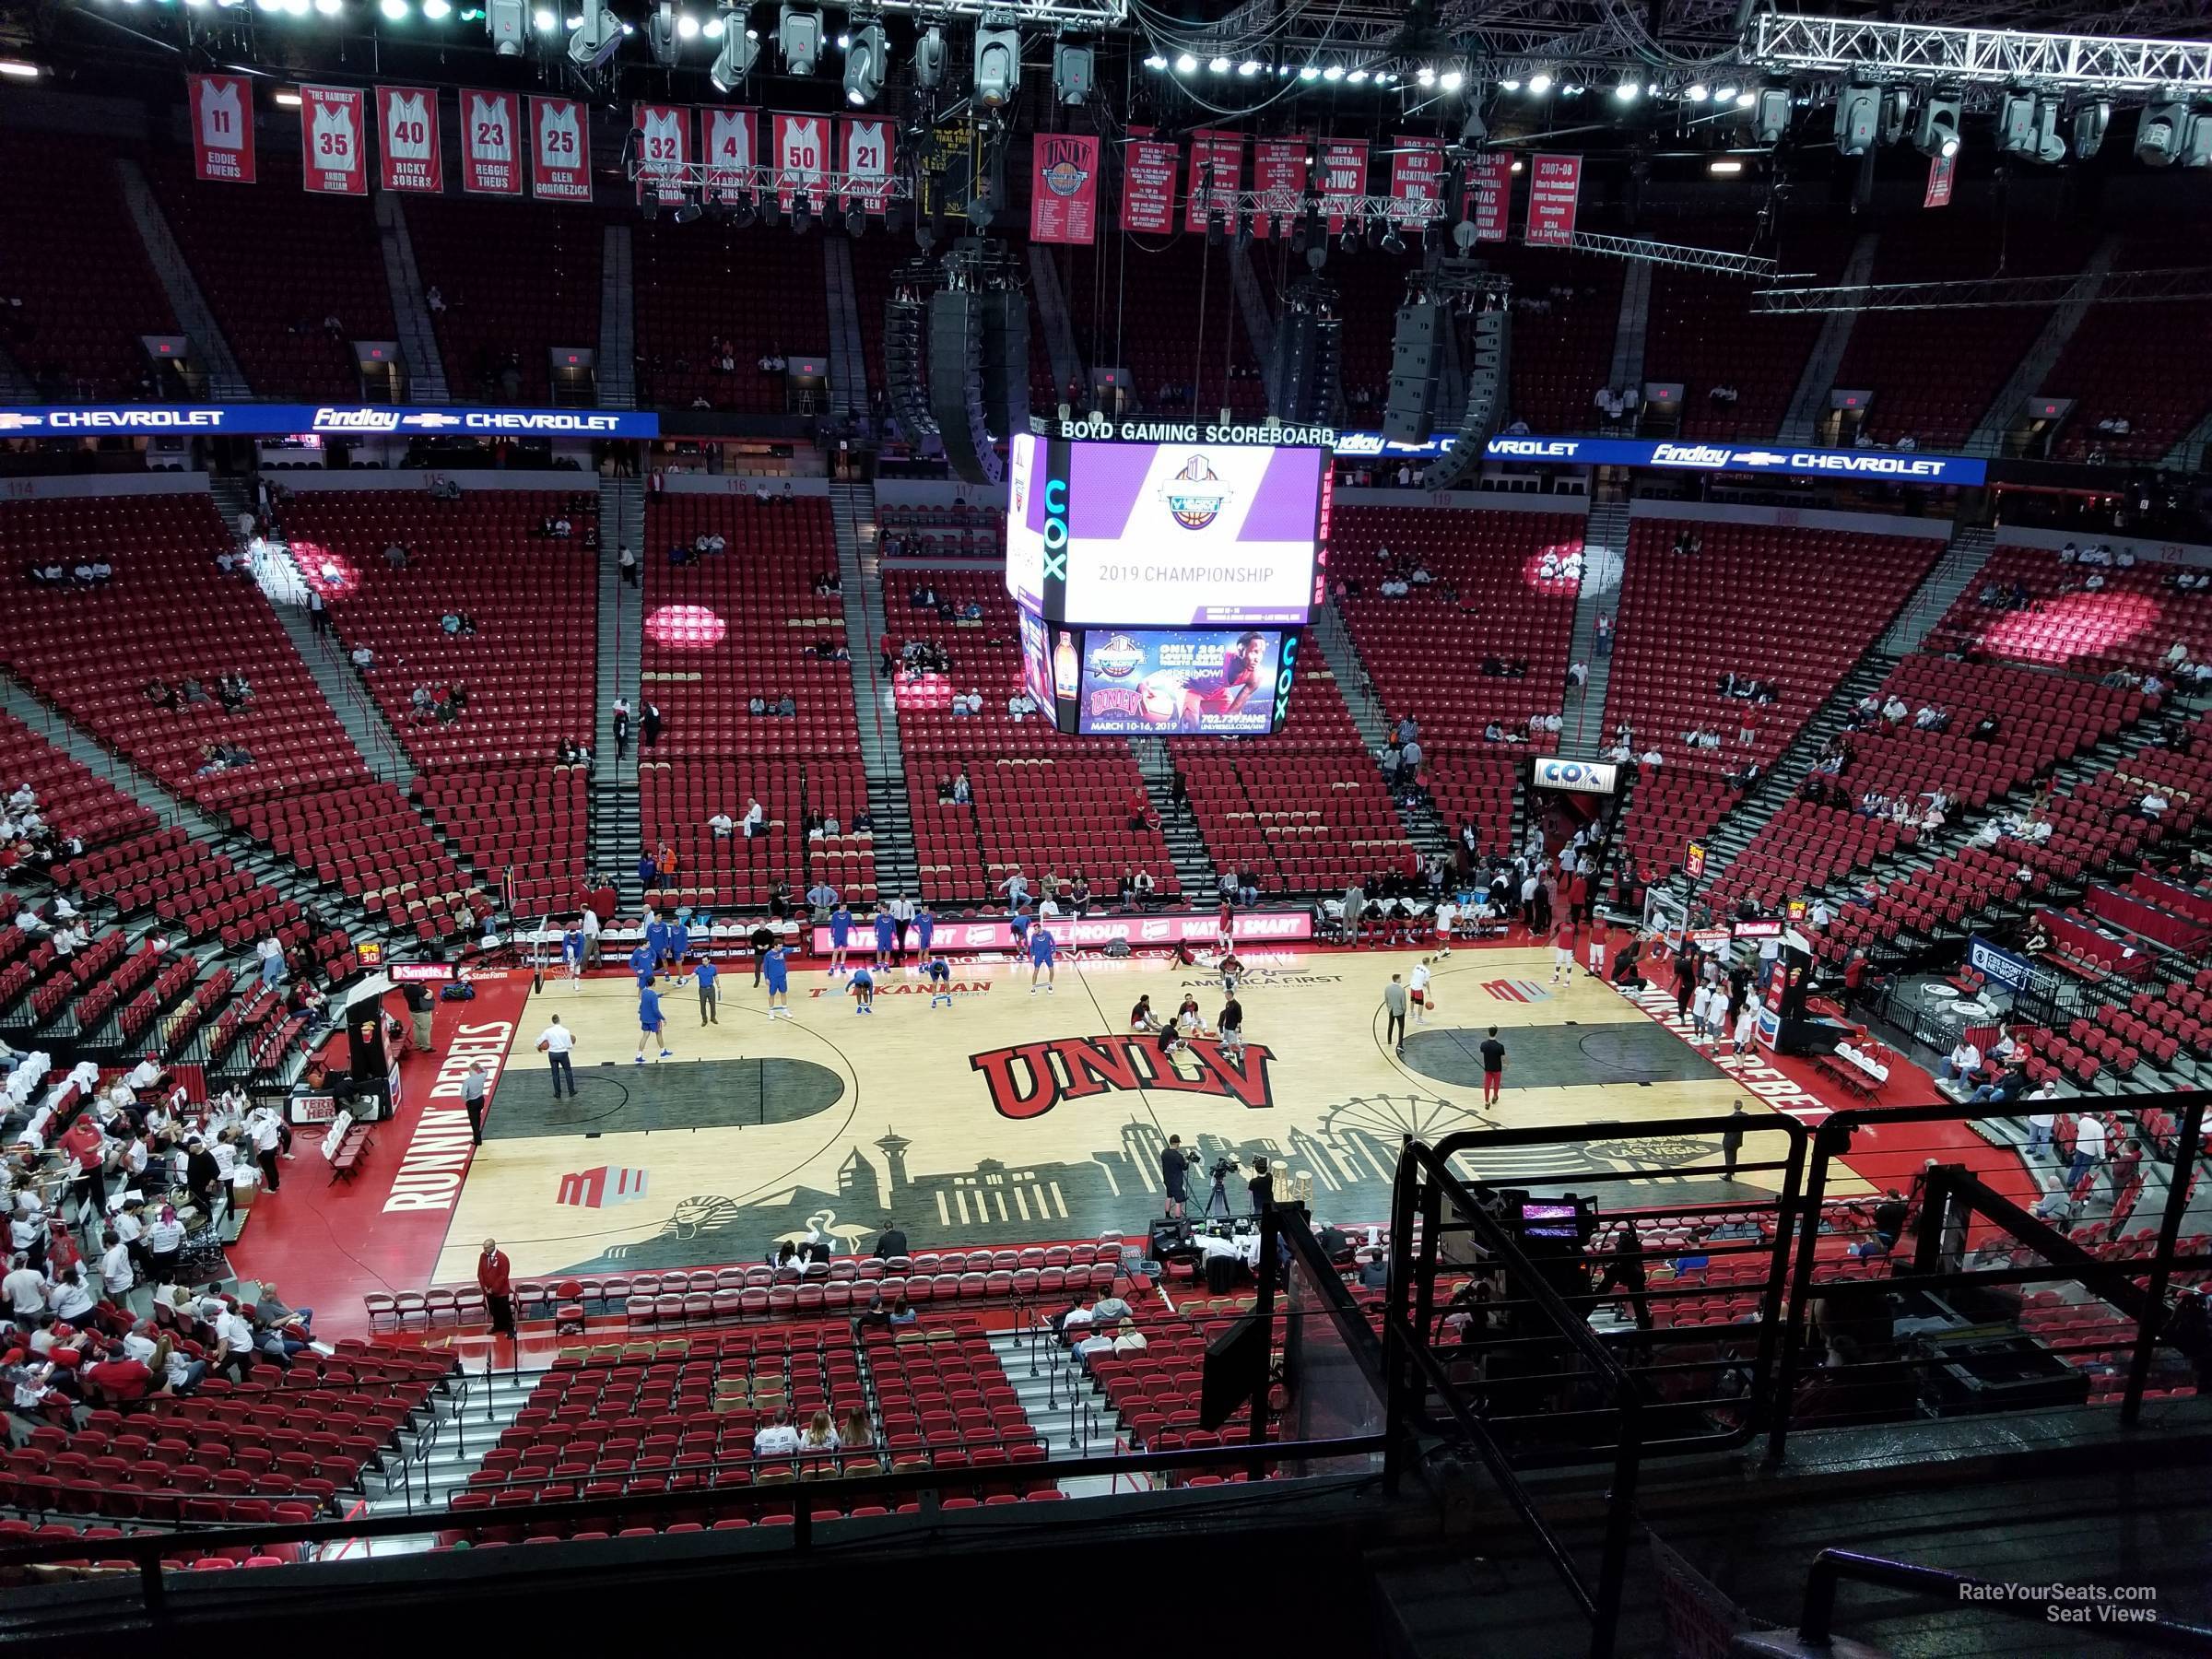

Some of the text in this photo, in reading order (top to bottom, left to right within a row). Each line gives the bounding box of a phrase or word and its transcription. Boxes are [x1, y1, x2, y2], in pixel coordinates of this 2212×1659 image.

[212, 109, 230, 134] 11
[394, 121, 424, 144] 40
[477, 123, 504, 146] 23
[320, 132, 347, 156] 35
[547, 131, 574, 153] 25
[650, 136, 676, 159] 32
[724, 136, 737, 158] 4
[207, 151, 237, 167] EDDIE
[789, 146, 815, 168] 50
[856, 146, 877, 169] 21
[1041, 138, 1091, 170] UNLV
[1324, 156, 1361, 166] ASKETBALL
[1407, 157, 1429, 168] MEN'S
[206, 164, 241, 178] OWENS
[396, 162, 426, 174] RICKY
[476, 164, 509, 177] REGGIE
[392, 175, 431, 187] SOBERS
[477, 175, 508, 189] THEUS
[551, 171, 572, 183] GLEN
[1406, 184, 1426, 199] WAC
[50, 410, 224, 428] CHEVROLET
[313, 407, 619, 430] Findlay CHEVROLET
[1062, 421, 1113, 440] BOYD
[1121, 422, 1197, 441] GAMING
[1206, 426, 1335, 445] SCOREBOARD
[1441, 439, 1579, 456] CVROLET
[1652, 444, 1945, 476] Findlay CHEVROLET
[727, 479, 747, 492] 116
[955, 485, 973, 496] 117
[1432, 493, 1452, 505] 119
[1043, 479, 1067, 581] COX
[2160, 546, 2183, 560] 121
[1099, 565, 1274, 583] 2019 CHAMPIONSHIP
[1194, 669, 1224, 677] NOW!
[1275, 637, 1297, 721] COX
[1091, 688, 1143, 716] UNLV
[1091, 722, 1177, 731] MARCH 10-16, 2019
[1545, 762, 1601, 789] COX
[1688, 855, 1700, 873] 30
[1790, 910, 1801, 918] 30
[1070, 924, 1130, 940] PROUD
[1243, 918, 1301, 935] SMART
[363, 953, 376, 962] 30
[1988, 955, 2002, 966] CBS
[1181, 975, 1343, 987] AMEICA FIRST
[968, 1034, 1278, 1120] UNLV
[1712, 1054, 1834, 1126] REBEL
[1607, 1146, 1712, 1158] LAS VEGAS
